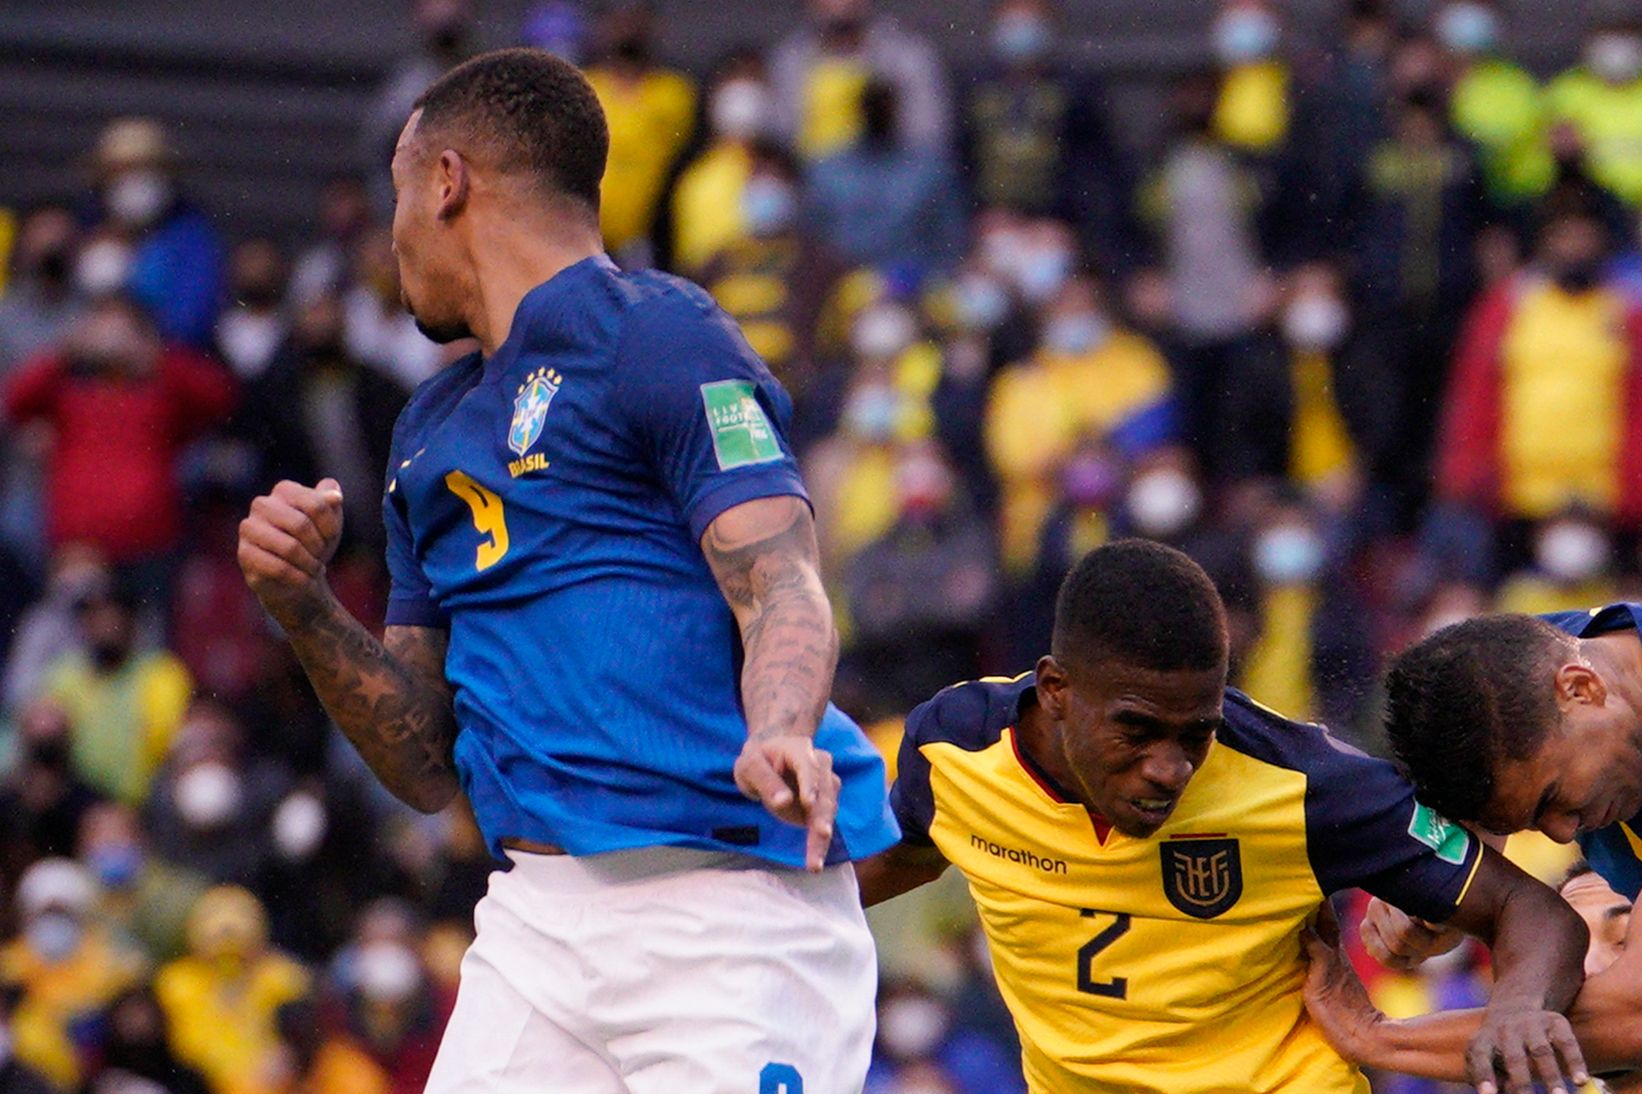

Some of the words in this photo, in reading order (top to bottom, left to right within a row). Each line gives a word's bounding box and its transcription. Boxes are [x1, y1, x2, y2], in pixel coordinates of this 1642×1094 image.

[444, 469, 509, 572] 9
[970, 834, 1068, 875] marathon
[1077, 907, 1131, 1000] 2
